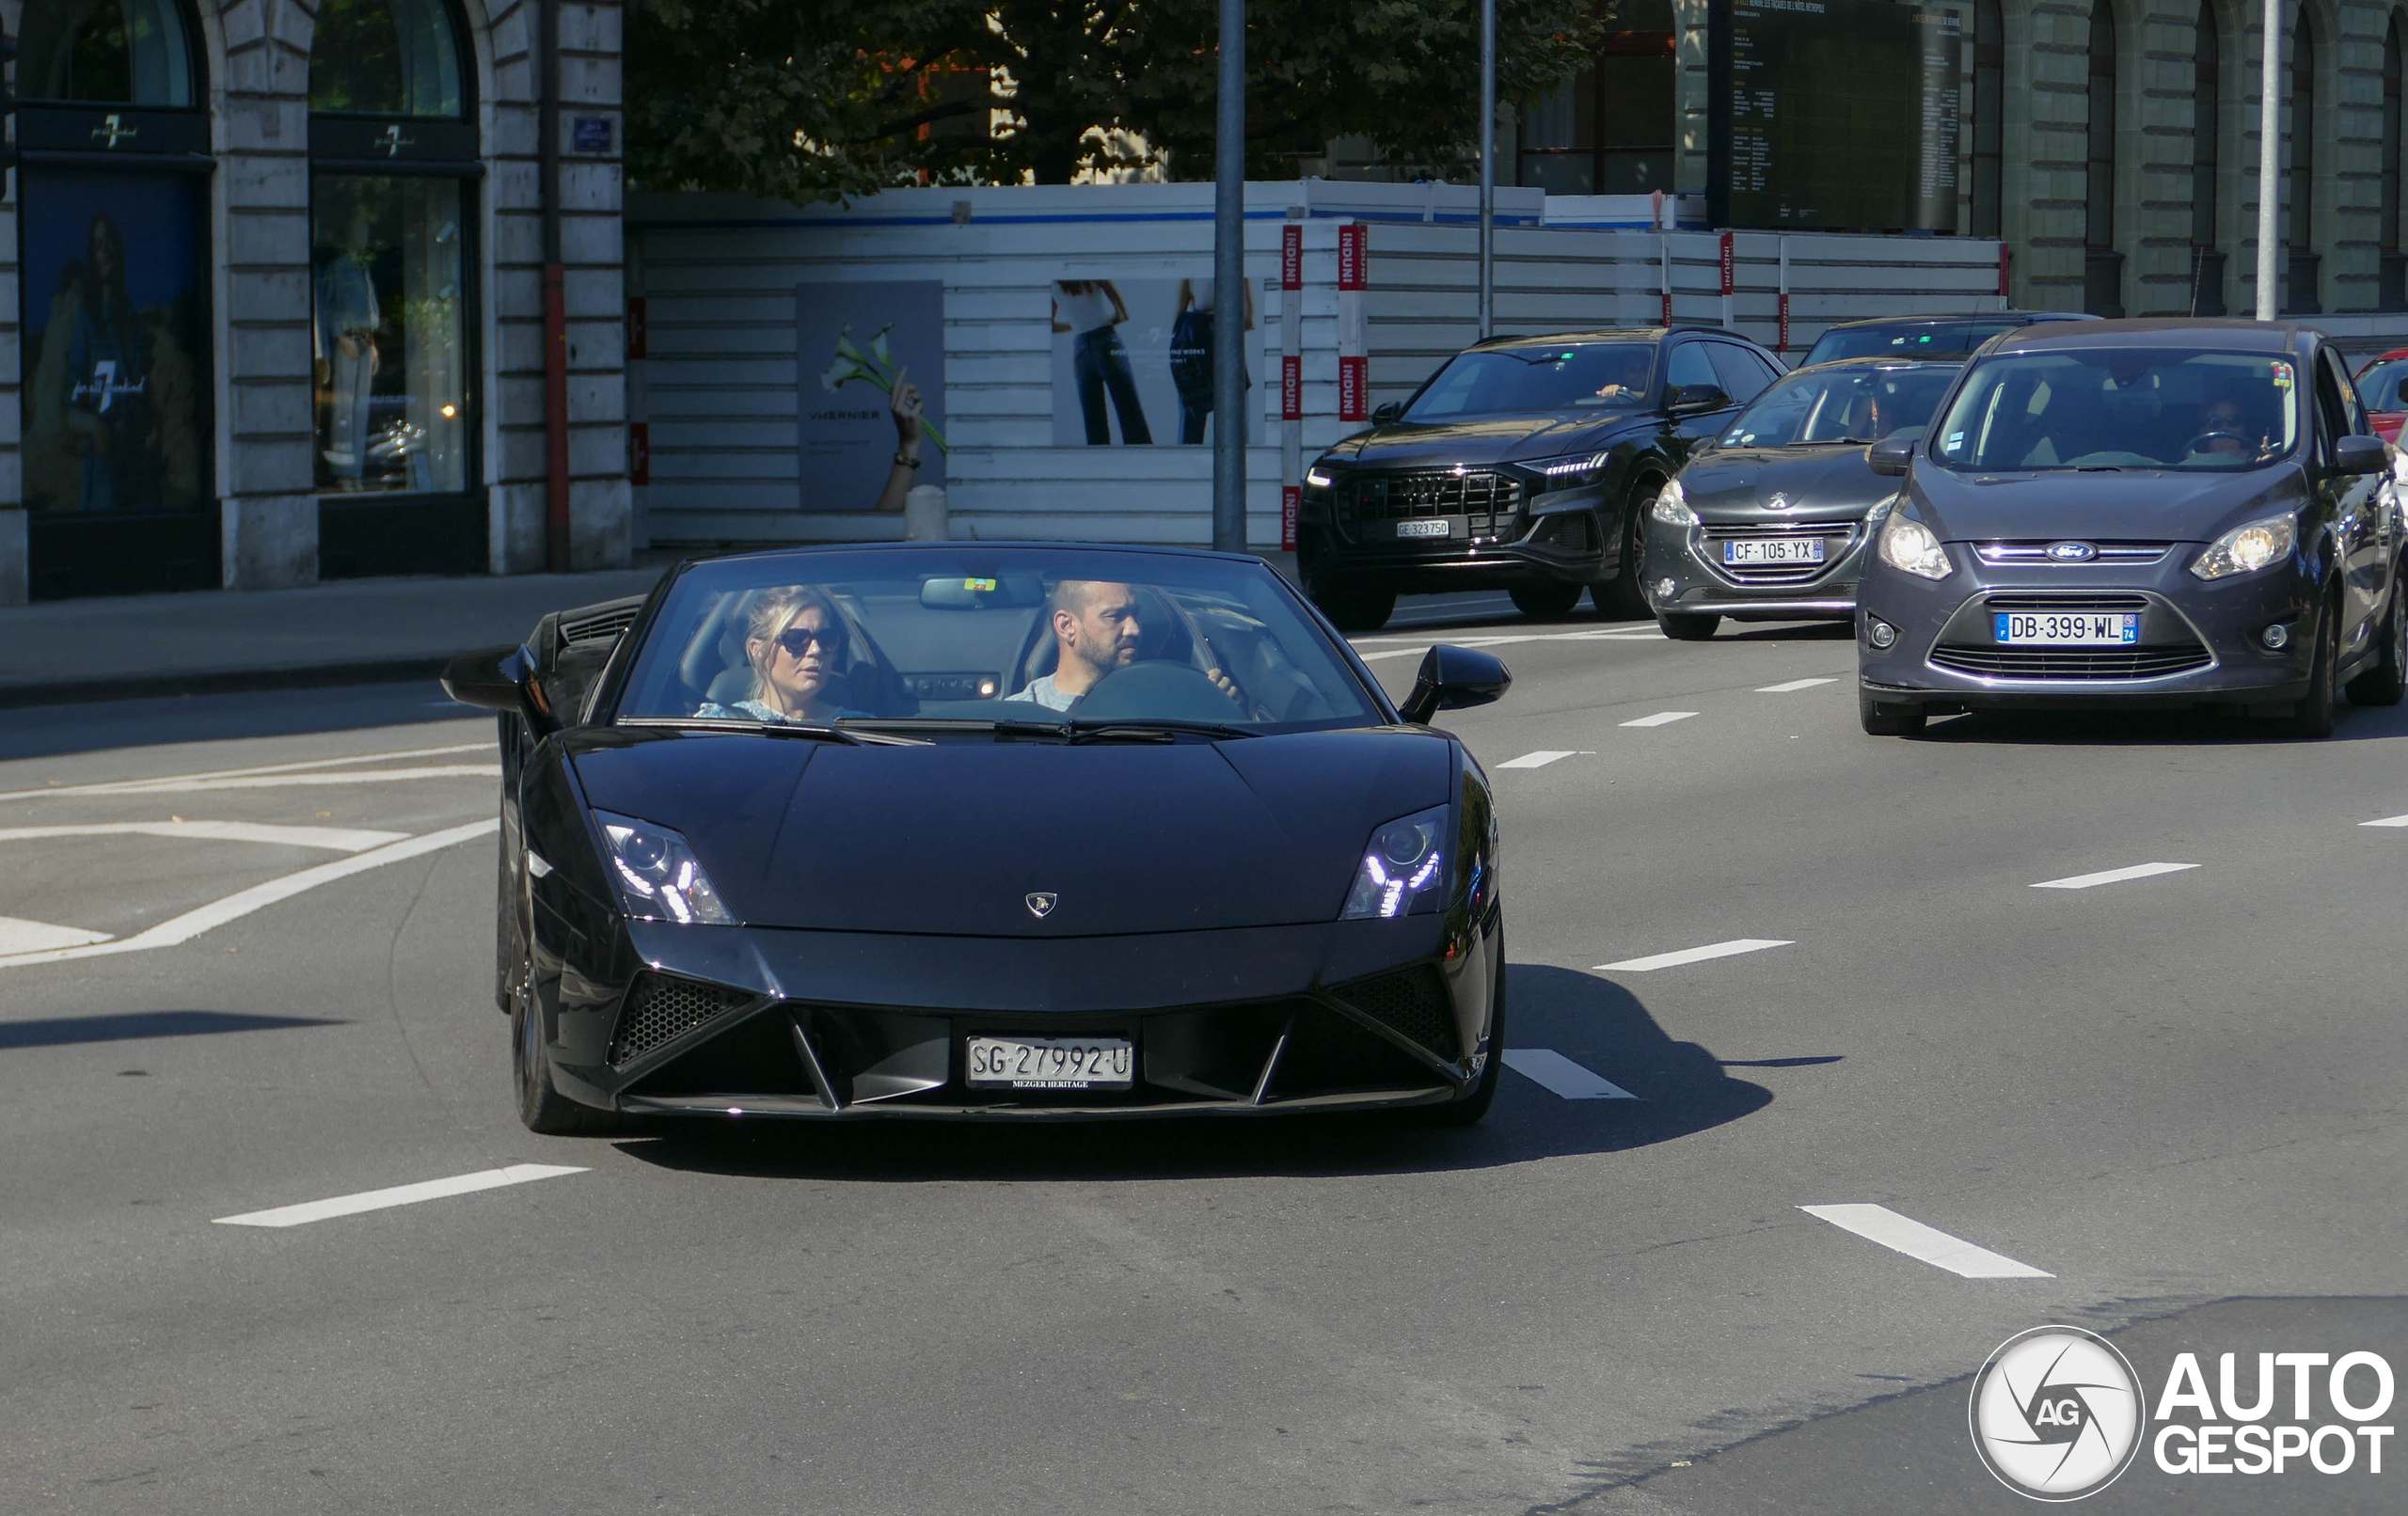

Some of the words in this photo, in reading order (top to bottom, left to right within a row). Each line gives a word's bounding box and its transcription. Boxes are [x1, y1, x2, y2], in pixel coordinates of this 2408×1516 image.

[1286, 232, 1297, 282] INDUNI
[1342, 232, 1354, 283] INDUNI
[1286, 363, 1296, 413] INDUNI
[1343, 364, 1354, 415] INDUNI
[809, 410, 880, 420] VHERNIER
[1286, 493, 1296, 544] INDUNI
[1735, 542, 1811, 560] CF-105-YX
[1814, 549, 1822, 558] 01
[2012, 616, 2120, 639] DB-399-WL
[2123, 629, 2134, 640] 74
[1012, 1080, 1047, 1088] MEZGER
[1047, 1080, 1089, 1088] HERITAGE
